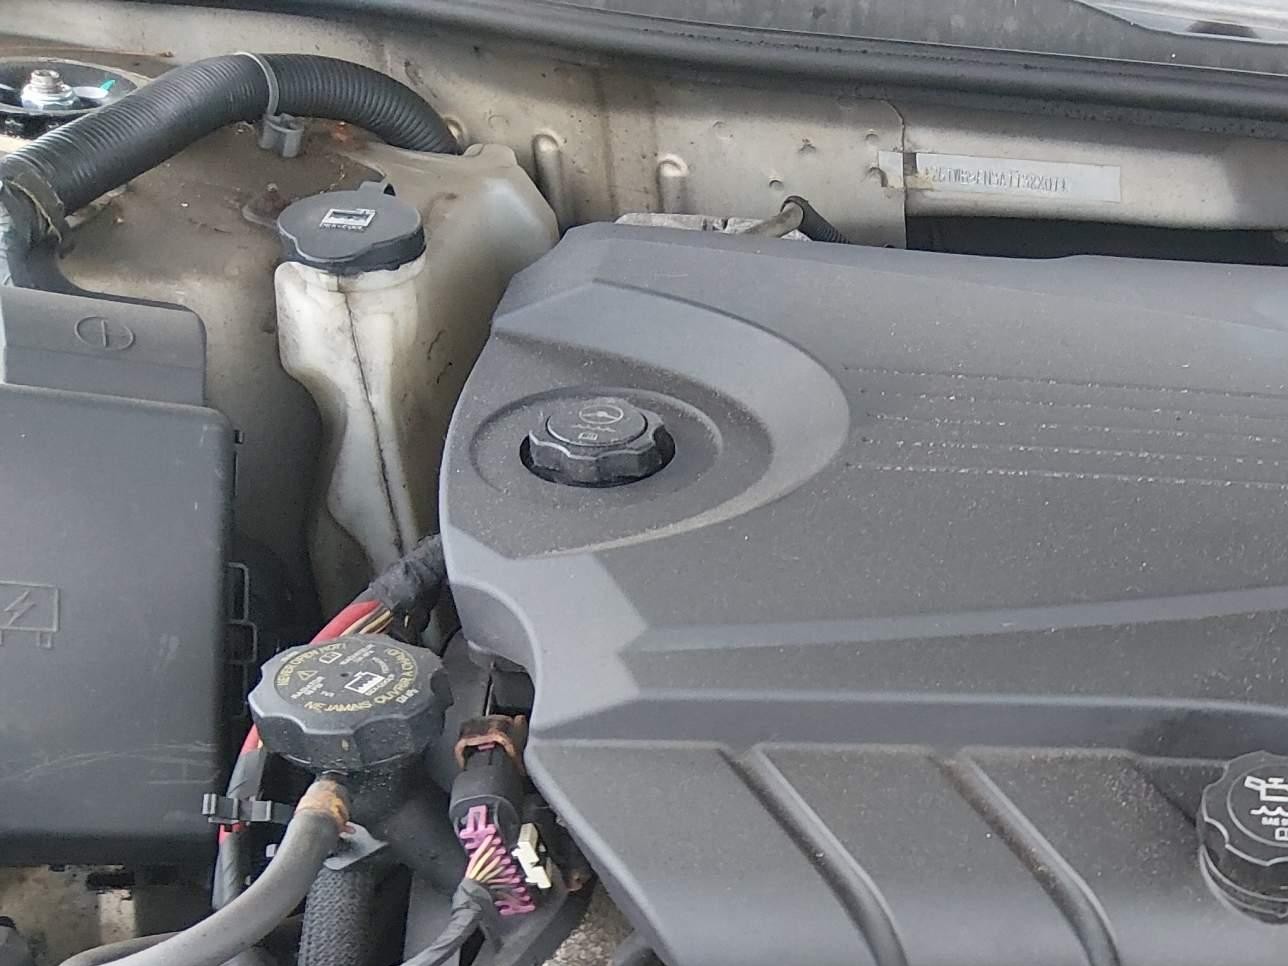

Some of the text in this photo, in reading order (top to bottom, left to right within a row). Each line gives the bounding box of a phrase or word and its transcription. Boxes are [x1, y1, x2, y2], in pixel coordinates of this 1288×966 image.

[276, 663, 297, 686] NEVER
[289, 649, 320, 665] OPEN
[304, 701, 322, 713] NE
[322, 700, 373, 713] JAMAIS
[374, 677, 411, 704] OUVRIR
